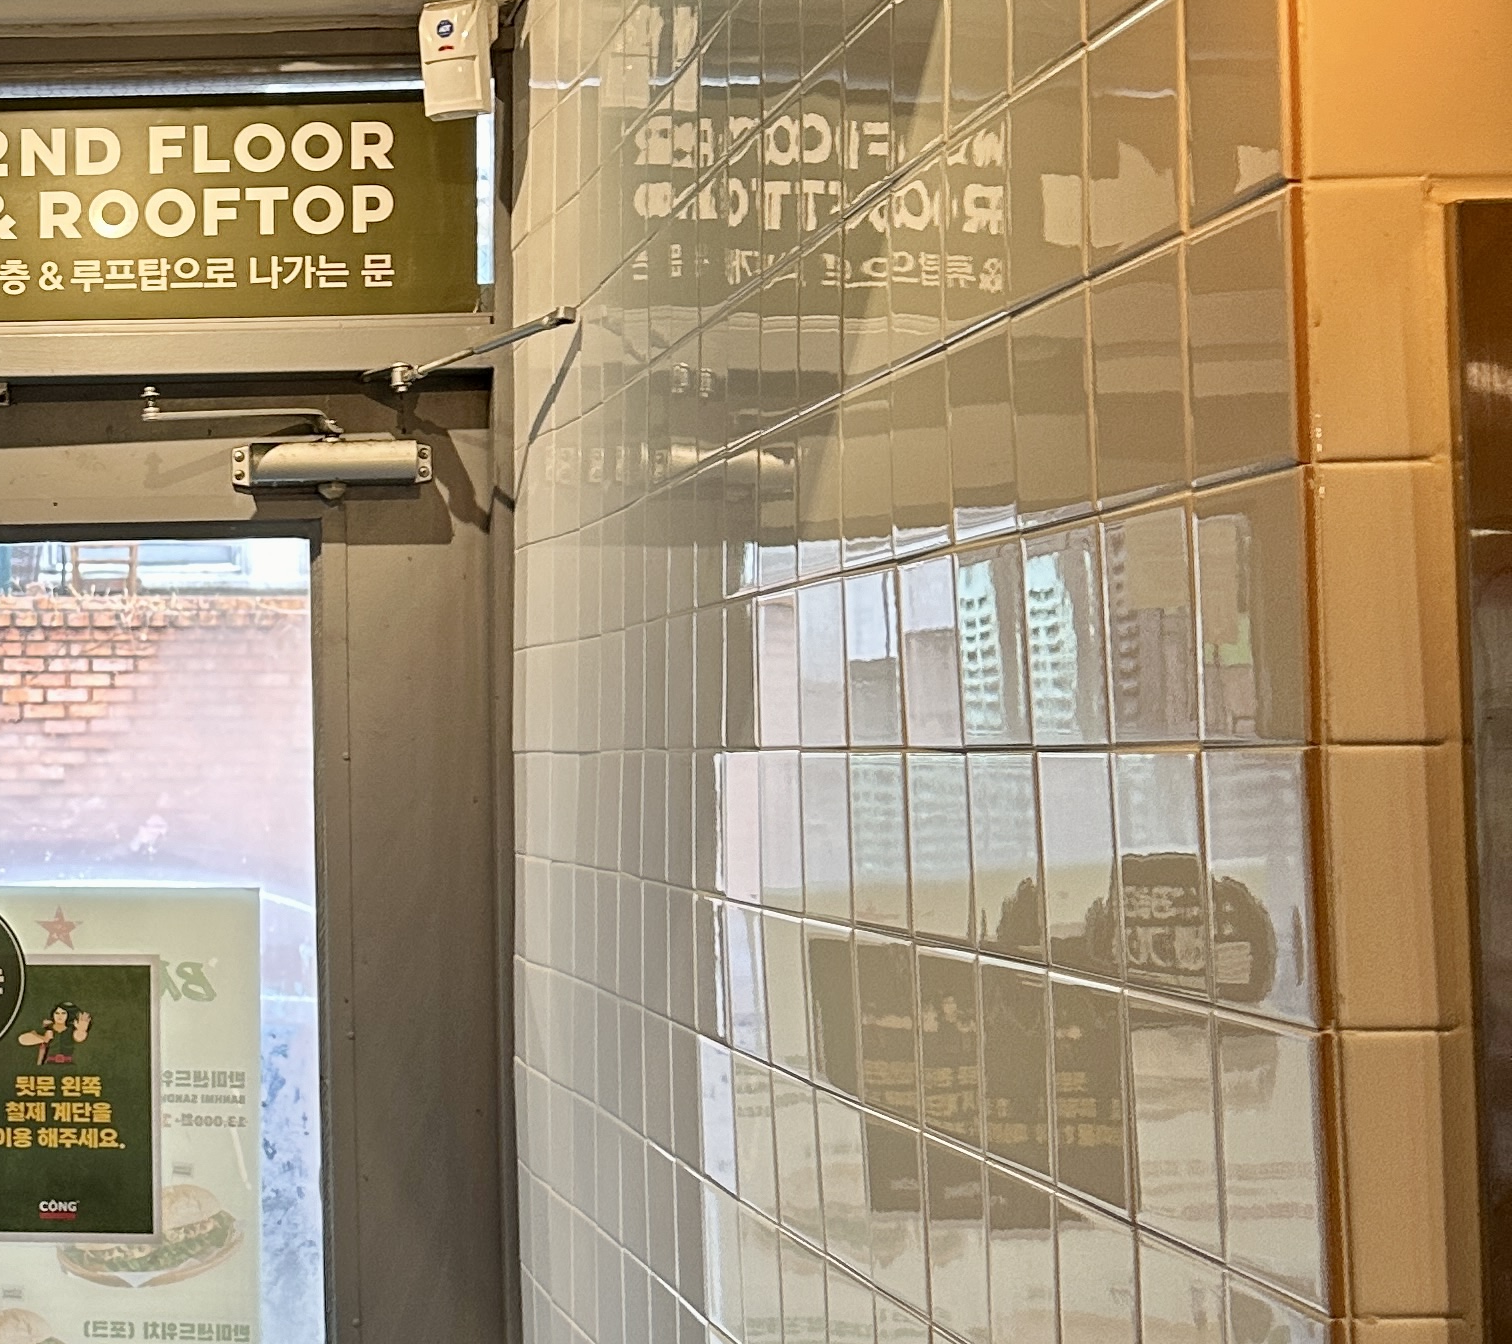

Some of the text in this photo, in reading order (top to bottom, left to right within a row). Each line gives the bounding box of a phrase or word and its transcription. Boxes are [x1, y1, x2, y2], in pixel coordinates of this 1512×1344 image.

[149, 121, 395, 174] FLOOR
[40, 184, 395, 239] ROOFTOP
[70, 257, 238, 292] 루프탑으로
[249, 255, 350, 289] 나가는
[360, 254, 395, 287] 문
[15, 1076, 102, 1097] 뒷문 왼쪽
[5, 1101, 113, 1123] 철제 계단을
[37, 1127, 126, 1149] 해주세요.
